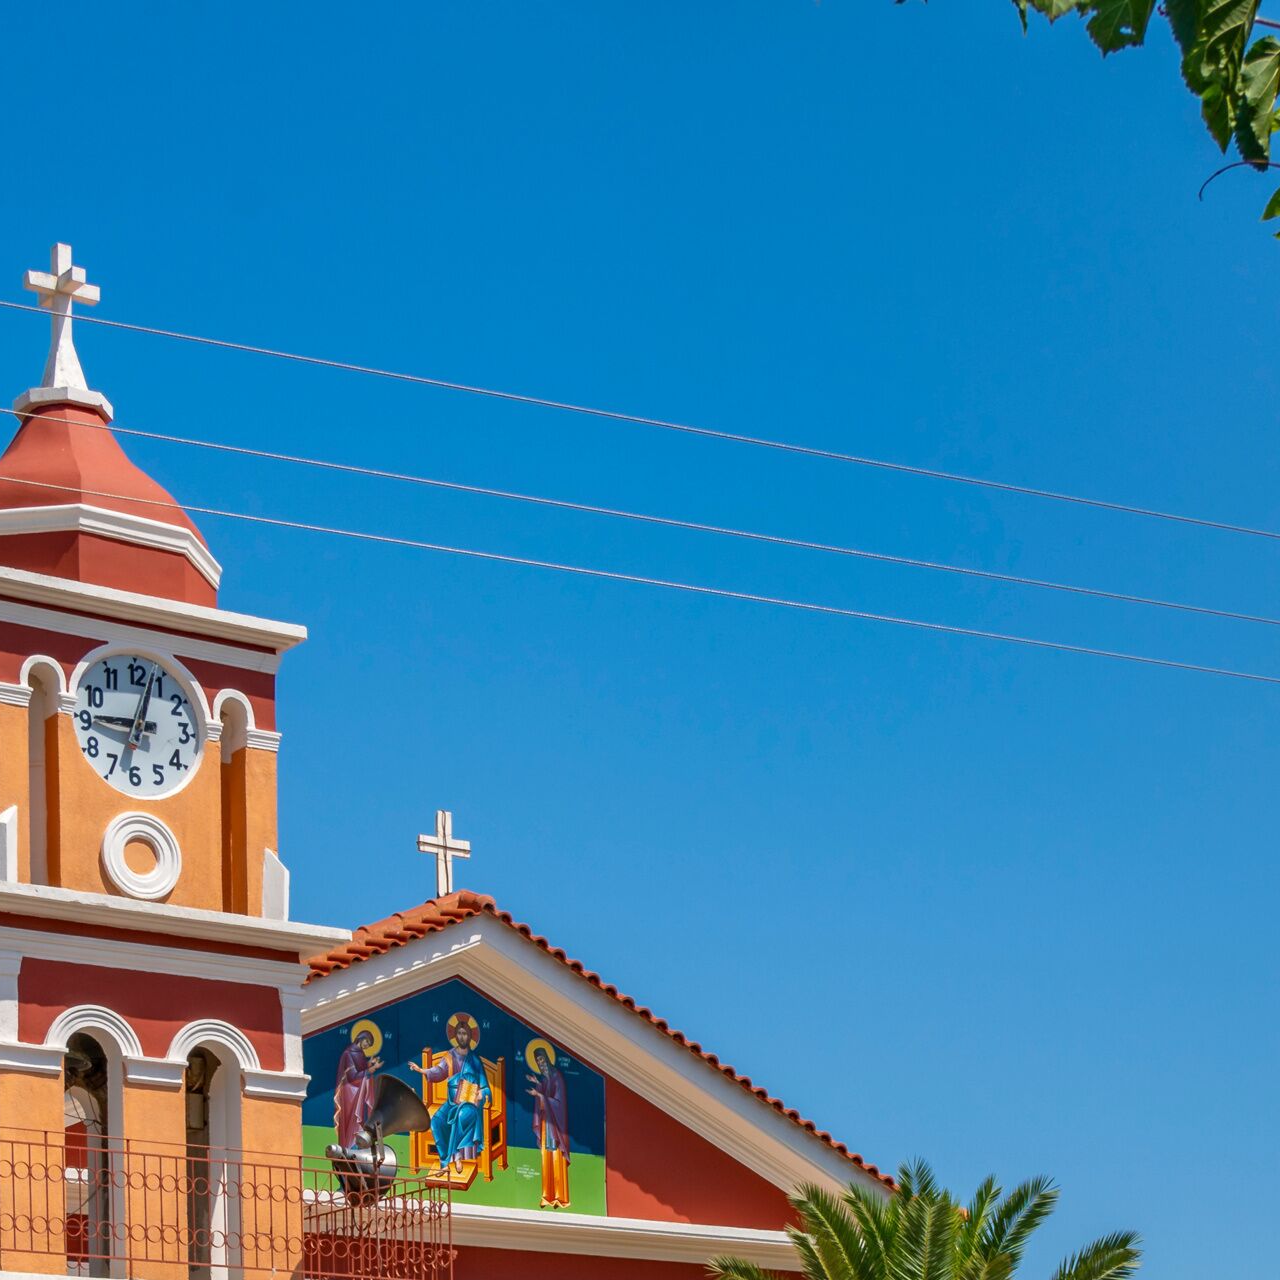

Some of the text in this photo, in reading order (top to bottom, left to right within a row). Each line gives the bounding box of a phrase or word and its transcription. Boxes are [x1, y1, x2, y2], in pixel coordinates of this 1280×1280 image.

[103, 667, 118, 690] 11
[127, 663, 147, 687] 12
[84, 684, 104, 708] 10
[155, 676, 163, 698] 1
[170, 694, 182, 716] 2
[80, 710, 91, 730] 9
[178, 722, 190, 744] 3
[87, 736, 99, 758] 8
[106, 753, 118, 775] 7
[169, 749, 182, 770] 4
[129, 766, 142, 786] 6
[152, 764, 164, 786] 5
